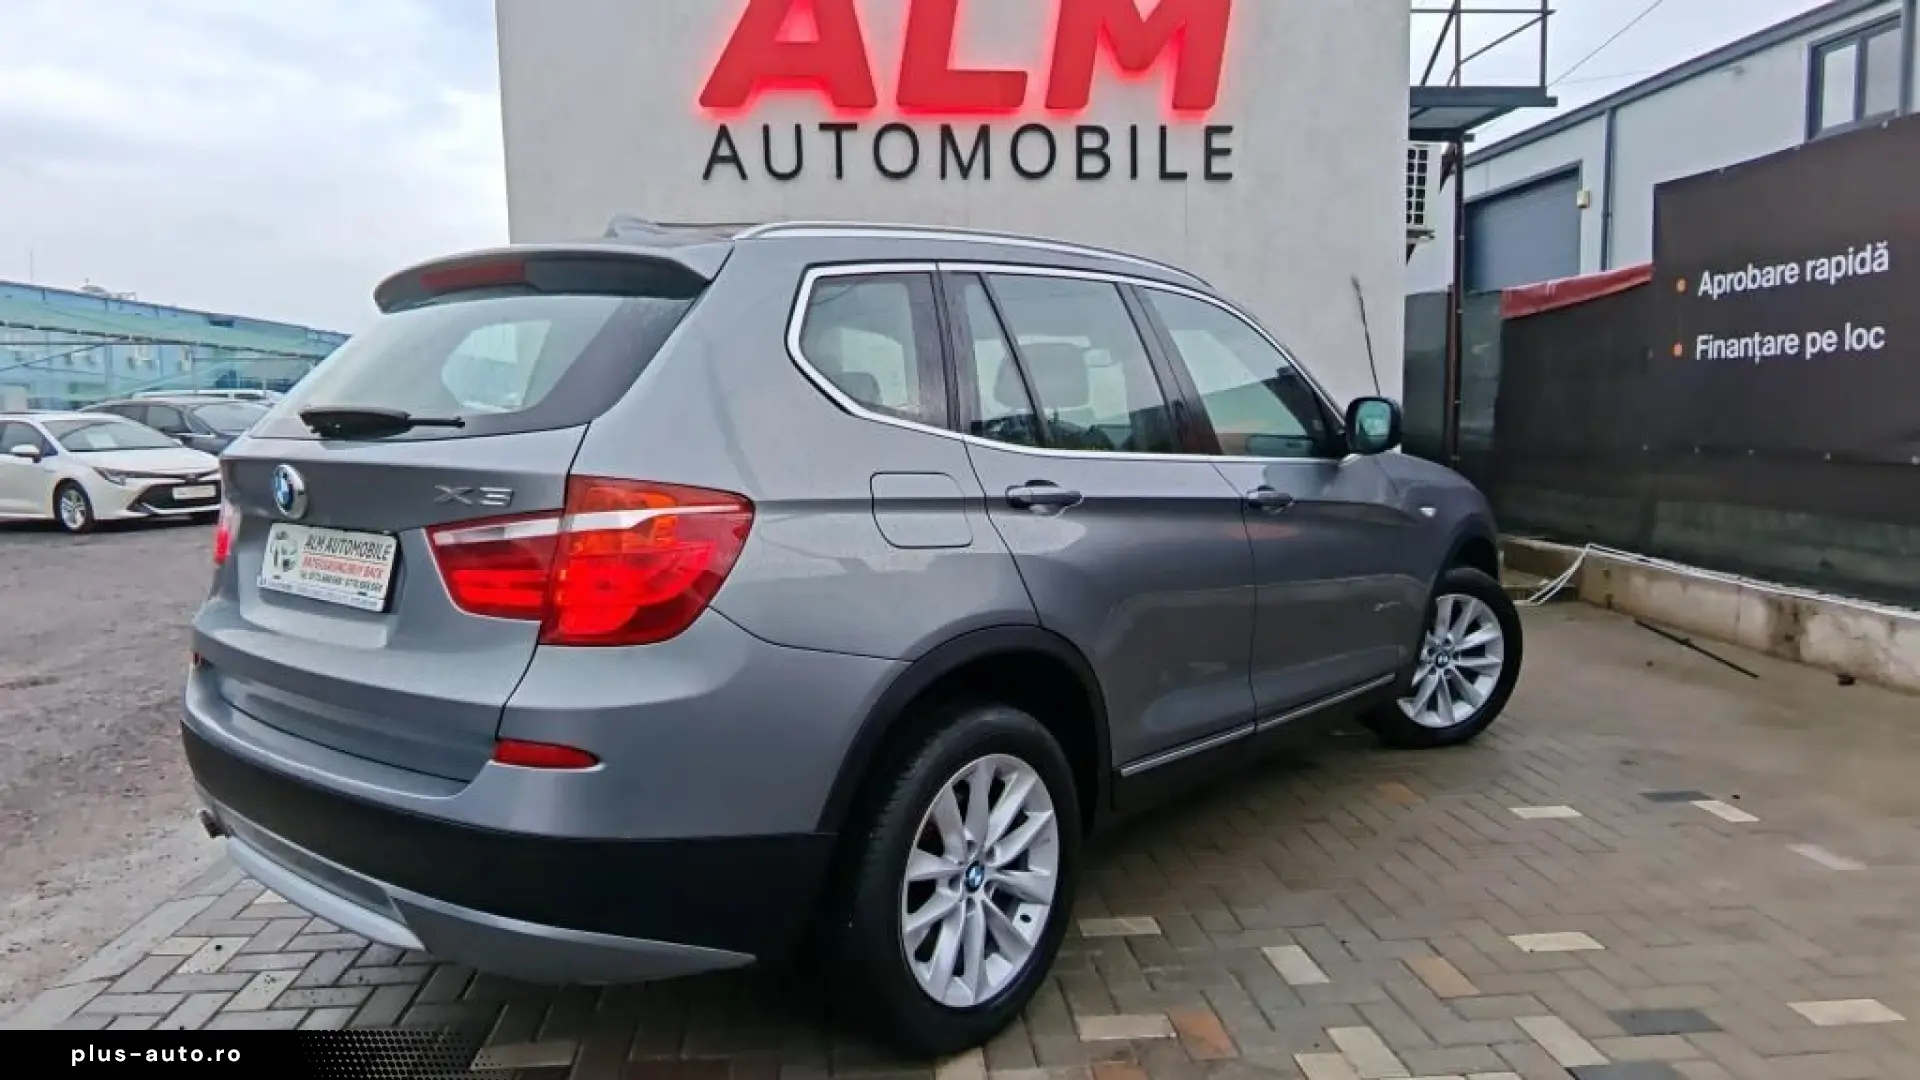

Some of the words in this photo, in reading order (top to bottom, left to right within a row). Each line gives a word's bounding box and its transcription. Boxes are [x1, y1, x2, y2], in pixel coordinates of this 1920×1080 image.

[699, 0, 1231, 110] ALM
[702, 122, 1234, 181] AUTOMOBILE
[1698, 262, 1799, 300] Aprobare
[1805, 240, 1890, 285] rapidă
[1696, 330, 1799, 365] Finanțare
[1805, 328, 1839, 360] pe
[1844, 321, 1886, 351] loc
[434, 484, 513, 507] X3
[303, 533, 329, 553] ALM
[325, 538, 392, 560] AUTOMOBILE
